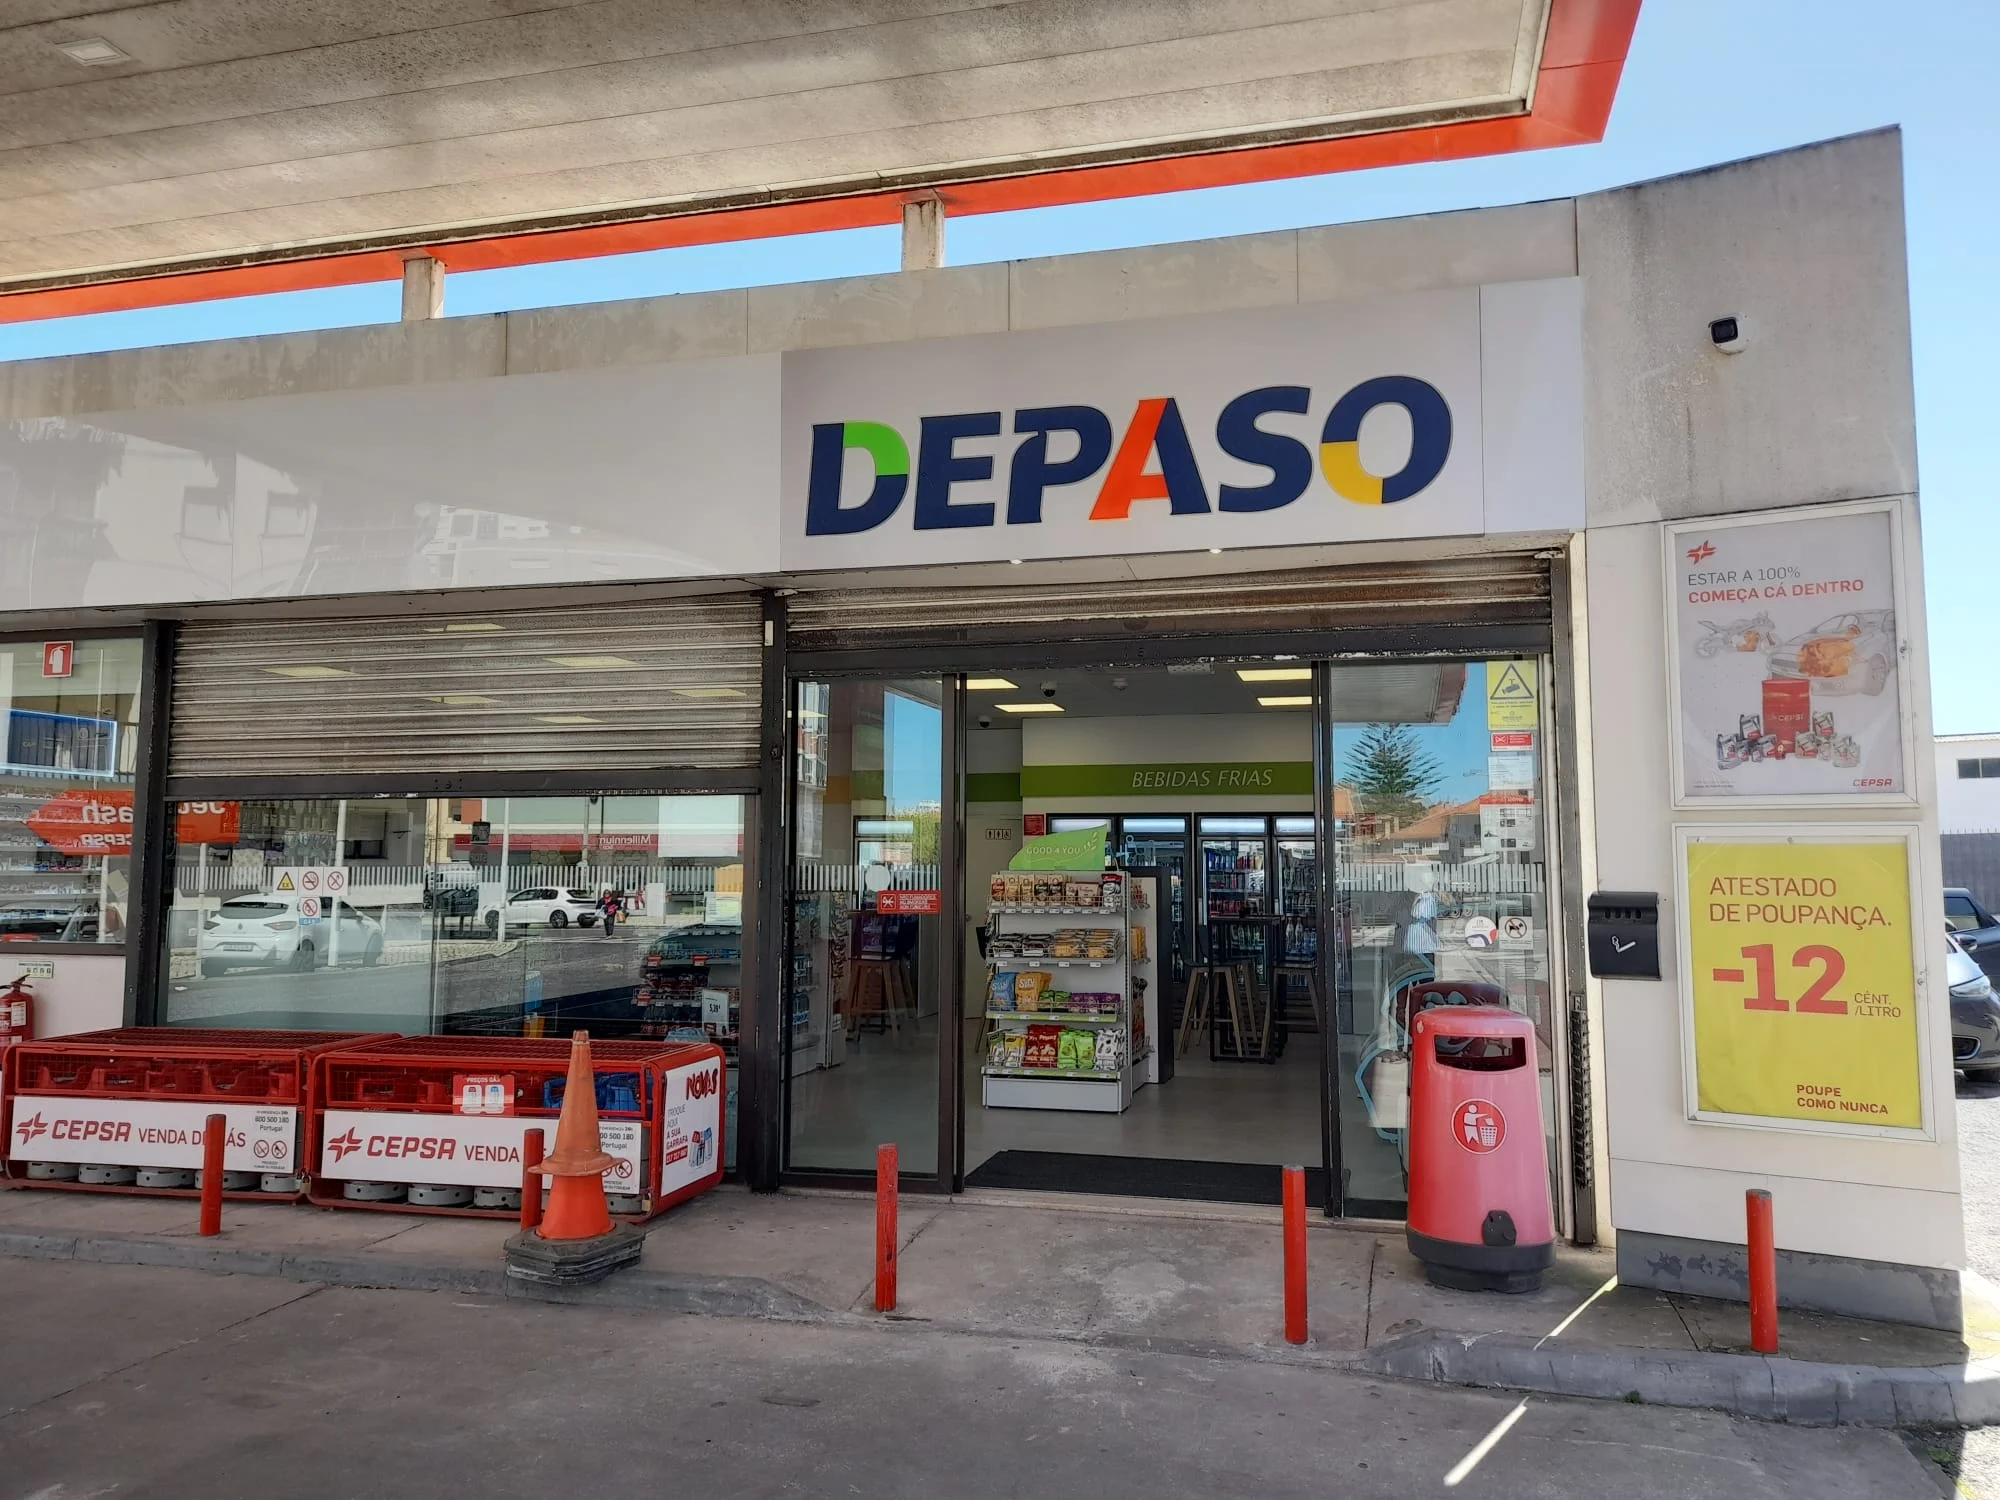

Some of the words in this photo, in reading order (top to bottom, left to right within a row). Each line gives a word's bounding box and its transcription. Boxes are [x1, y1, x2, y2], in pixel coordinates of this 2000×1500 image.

[805, 375, 1453, 537] DEPASO
[1687, 570, 1738, 586] ESTAR
[1742, 570, 1753, 582] A
[1758, 565, 1801, 582] 100%
[1688, 587, 1759, 604] COMEÇA
[1764, 581, 1788, 600] CÁ
[1792, 579, 1864, 597] DENTRO
[1132, 770, 1211, 788] BEBIDAS
[1217, 768, 1273, 787] FRIAS
[1852, 777, 1893, 788] CEPSA
[1026, 846, 1053, 855] GOOD
[1063, 847, 1081, 855] YOU
[1709, 876, 1838, 897] ATESTADO
[1709, 903, 1741, 922] DE
[1746, 903, 1892, 930] POUPANÇA.
[1712, 943, 1849, 1015] -12
[1854, 1005, 1902, 1018] /LITRO
[1796, 1084, 1842, 1097] POUPE
[1797, 1097, 1836, 1110] COMO
[1839, 1101, 1889, 1115] NUNCA
[52, 1119, 131, 1142] CEPSA
[139, 1128, 187, 1145] VENDA
[226, 1127, 246, 1148] ÁS
[260, 1124, 283, 1132] Portugal
[671, 1127, 681, 1137] SUA
[367, 1136, 456, 1160] CEPSA
[464, 1145, 519, 1162] VENDA
[601, 1142, 627, 1150] Portugal
[666, 1135, 688, 1149] GARRAFA
